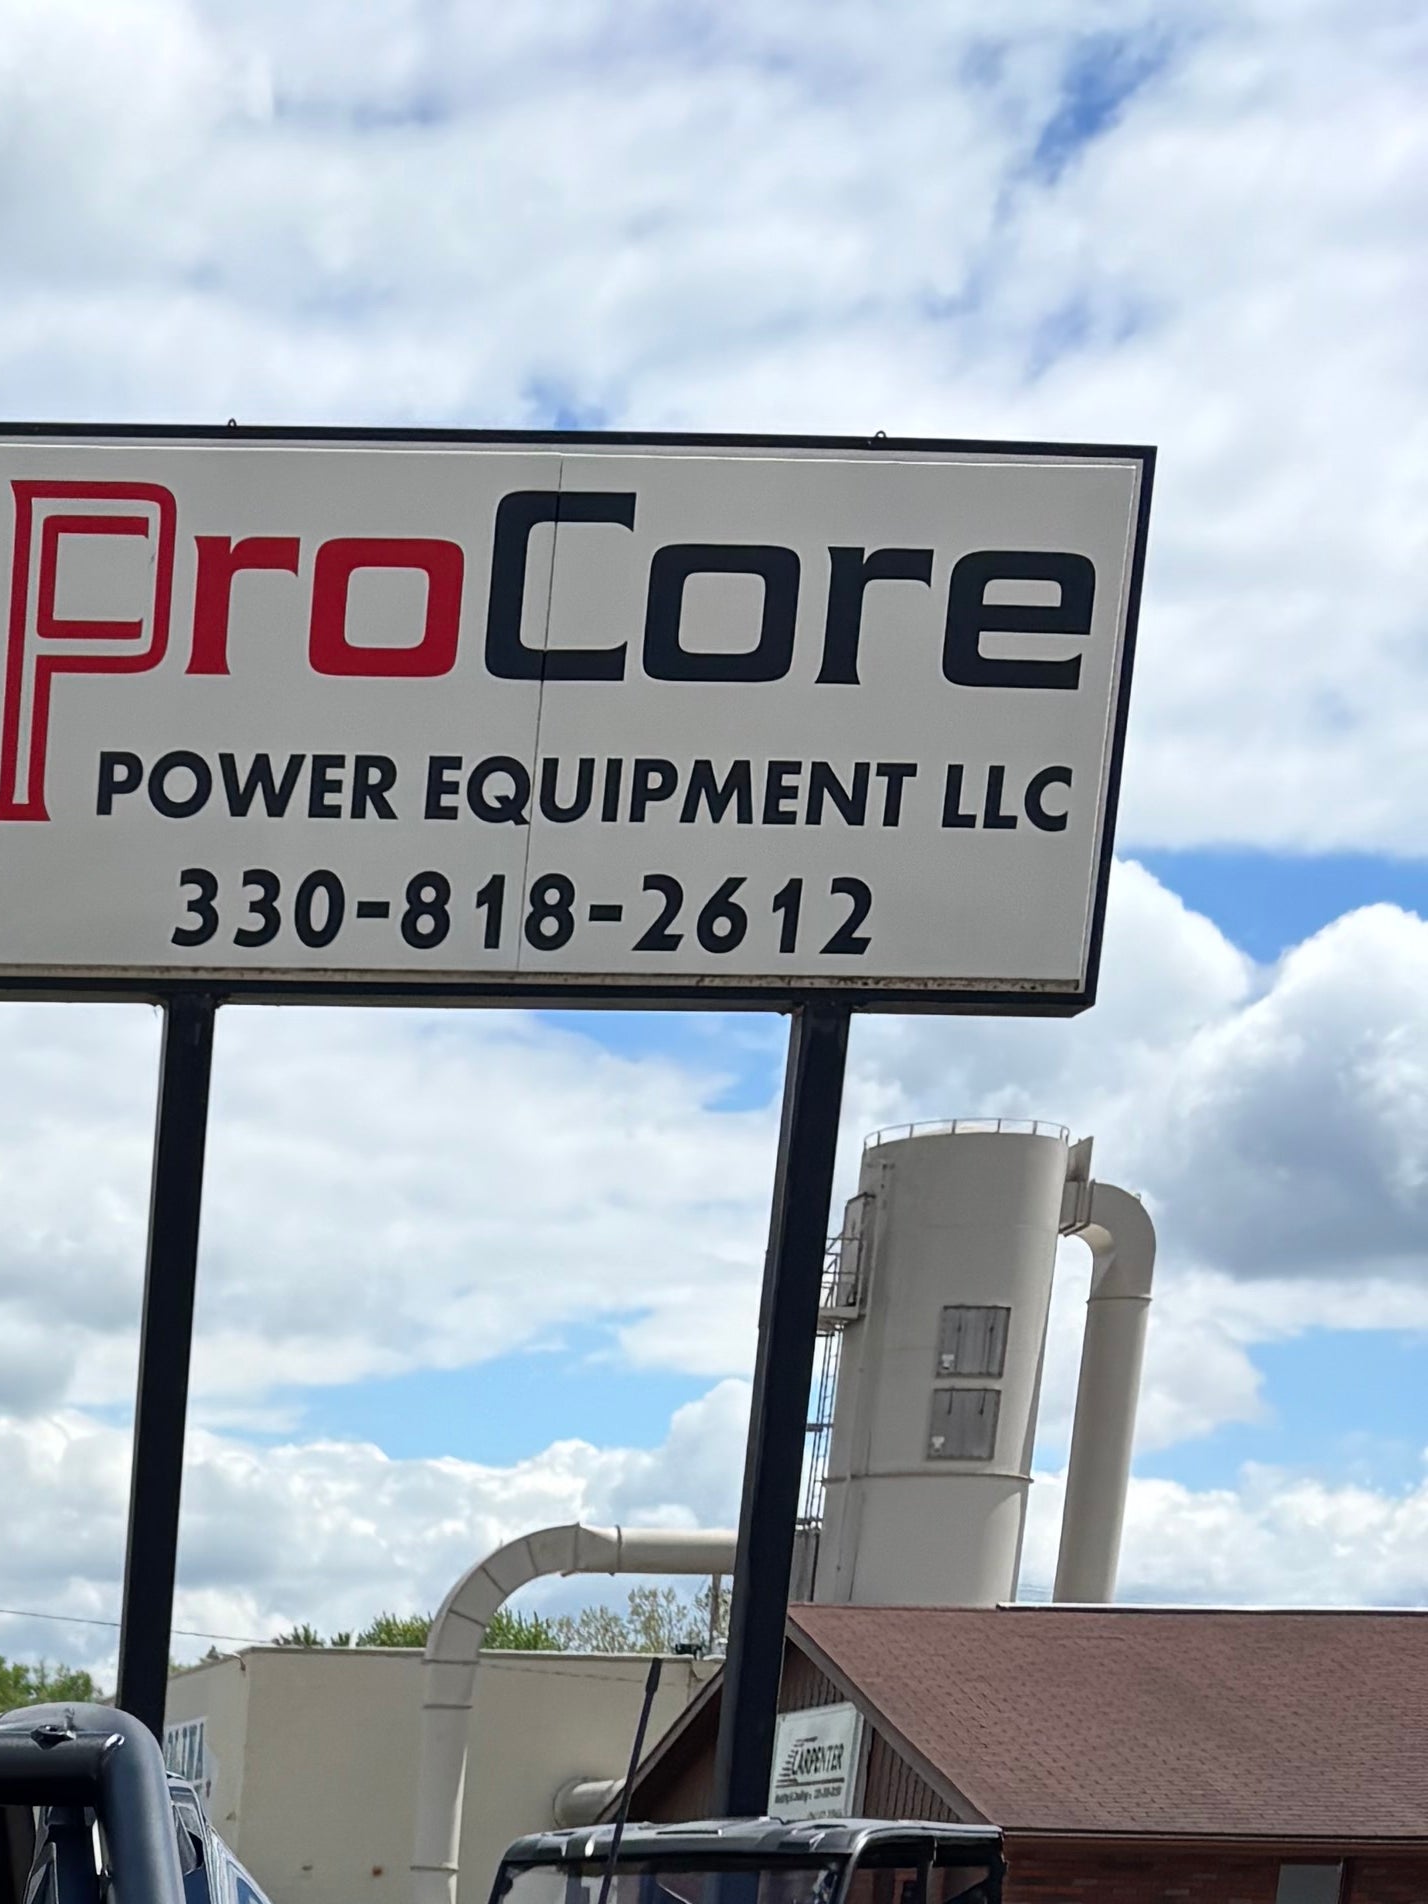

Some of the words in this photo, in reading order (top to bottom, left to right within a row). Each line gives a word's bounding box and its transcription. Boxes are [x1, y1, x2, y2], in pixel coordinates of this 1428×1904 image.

[95, 749, 398, 820] POWER
[424, 753, 918, 828] EQUIPMENT
[940, 763, 1073, 832] LLC
[170, 867, 874, 955] 330-818-2612
